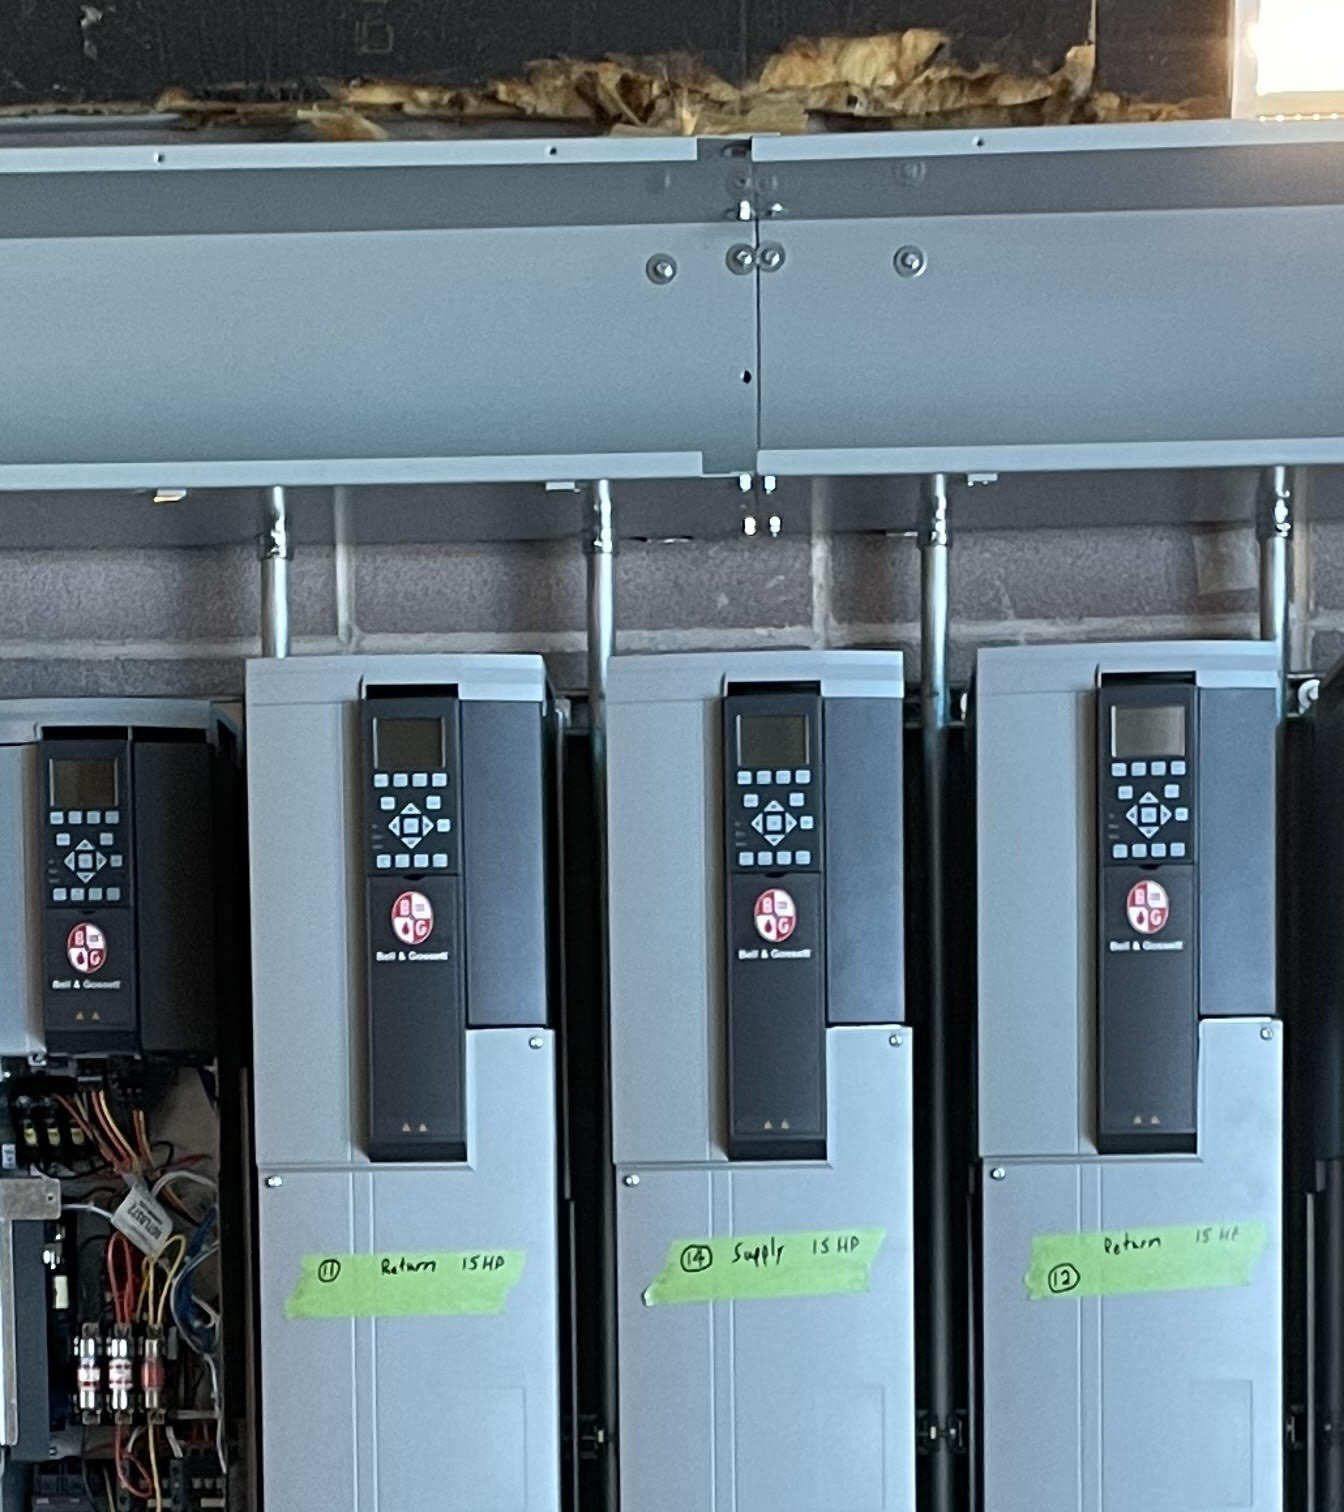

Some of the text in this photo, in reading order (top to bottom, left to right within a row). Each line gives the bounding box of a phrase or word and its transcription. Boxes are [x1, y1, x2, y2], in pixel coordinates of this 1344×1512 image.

[732, 1236, 784, 1267] Supply
[1103, 1232, 1161, 1255] Return
[381, 1257, 436, 1275] Return
